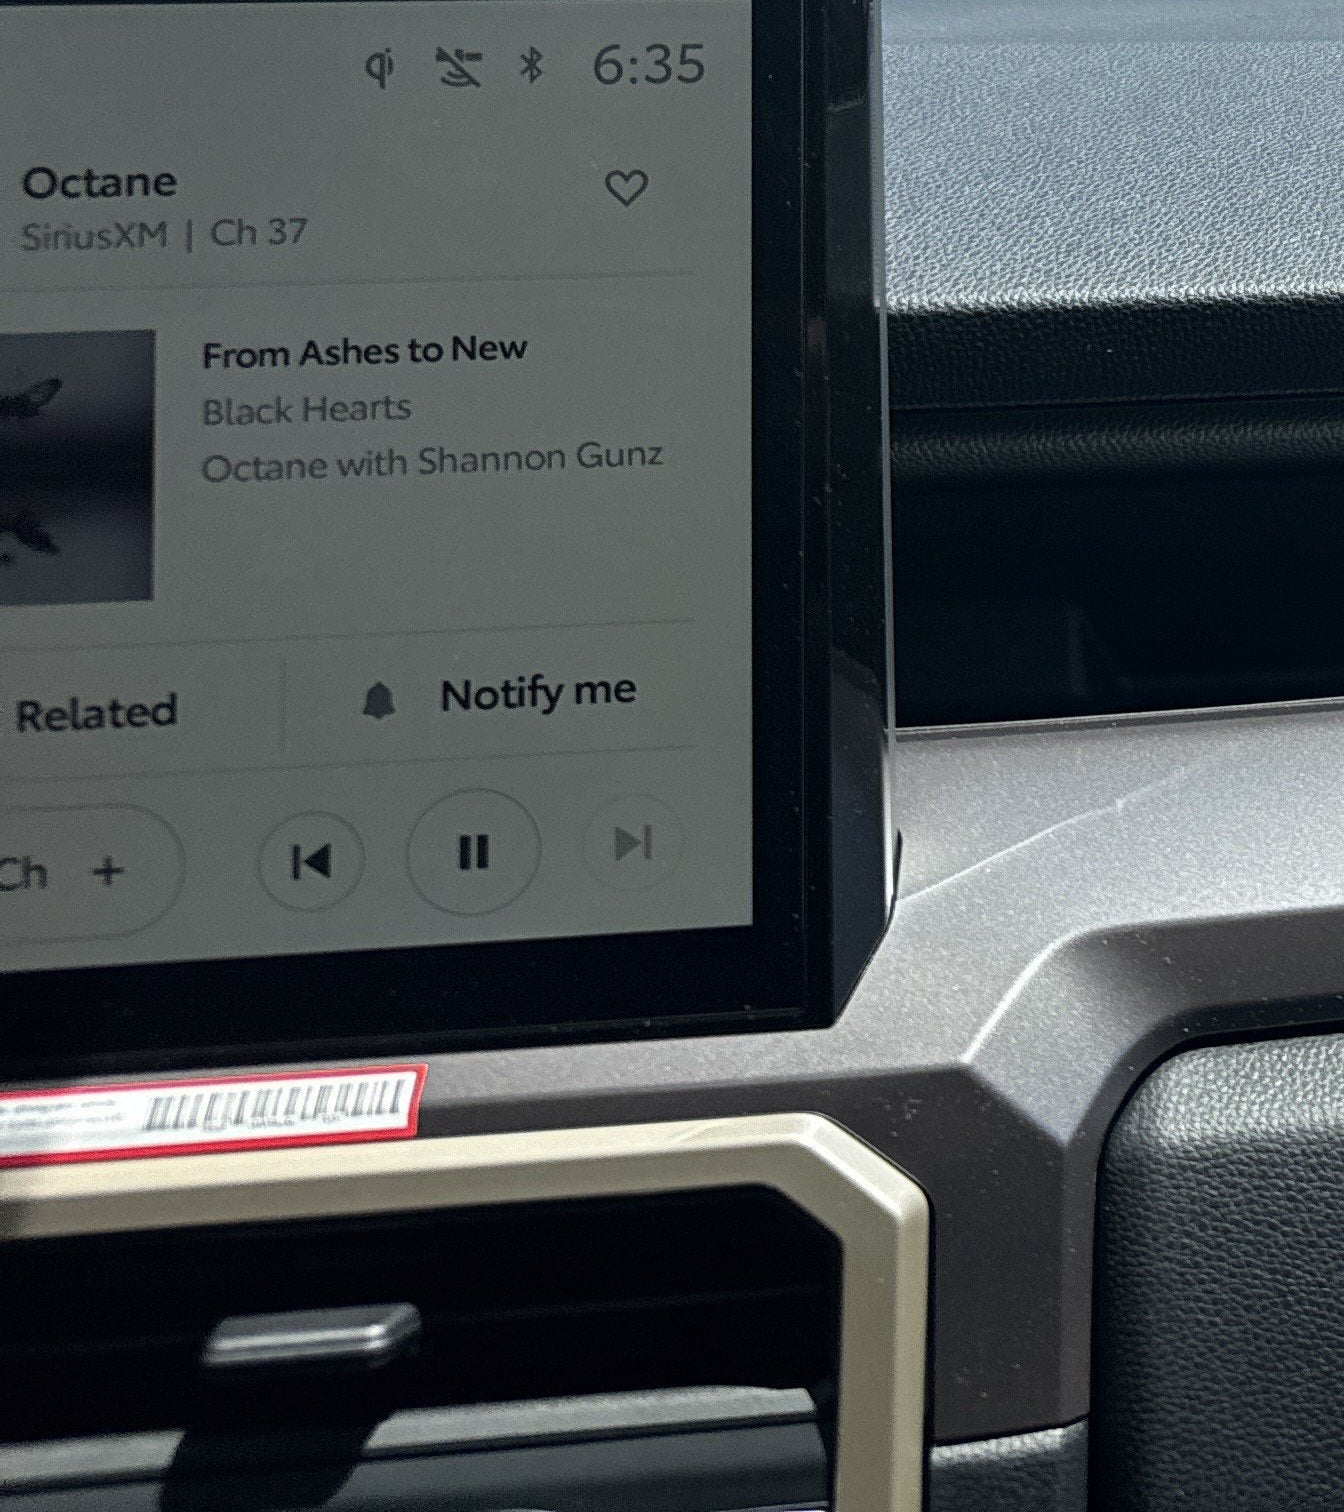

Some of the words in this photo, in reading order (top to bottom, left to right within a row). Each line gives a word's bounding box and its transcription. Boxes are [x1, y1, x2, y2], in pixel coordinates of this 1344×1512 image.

[593, 44, 705, 85] 6:35
[22, 166, 178, 199] Octane
[21, 220, 168, 252] SiriusXM
[211, 218, 257, 247] Ch
[268, 218, 308, 247] 37
[202, 341, 291, 369] From
[301, 338, 400, 366] Ashes
[408, 339, 442, 363] to
[451, 336, 528, 362] New
[202, 397, 292, 426] Black
[302, 394, 412, 422] Hearts
[202, 454, 328, 484] Octane
[336, 449, 408, 478] with
[418, 445, 566, 476] Shannon
[576, 441, 664, 469] Gunz
[442, 674, 564, 714] Notify
[574, 674, 637, 704] me
[16, 693, 178, 734] Related
